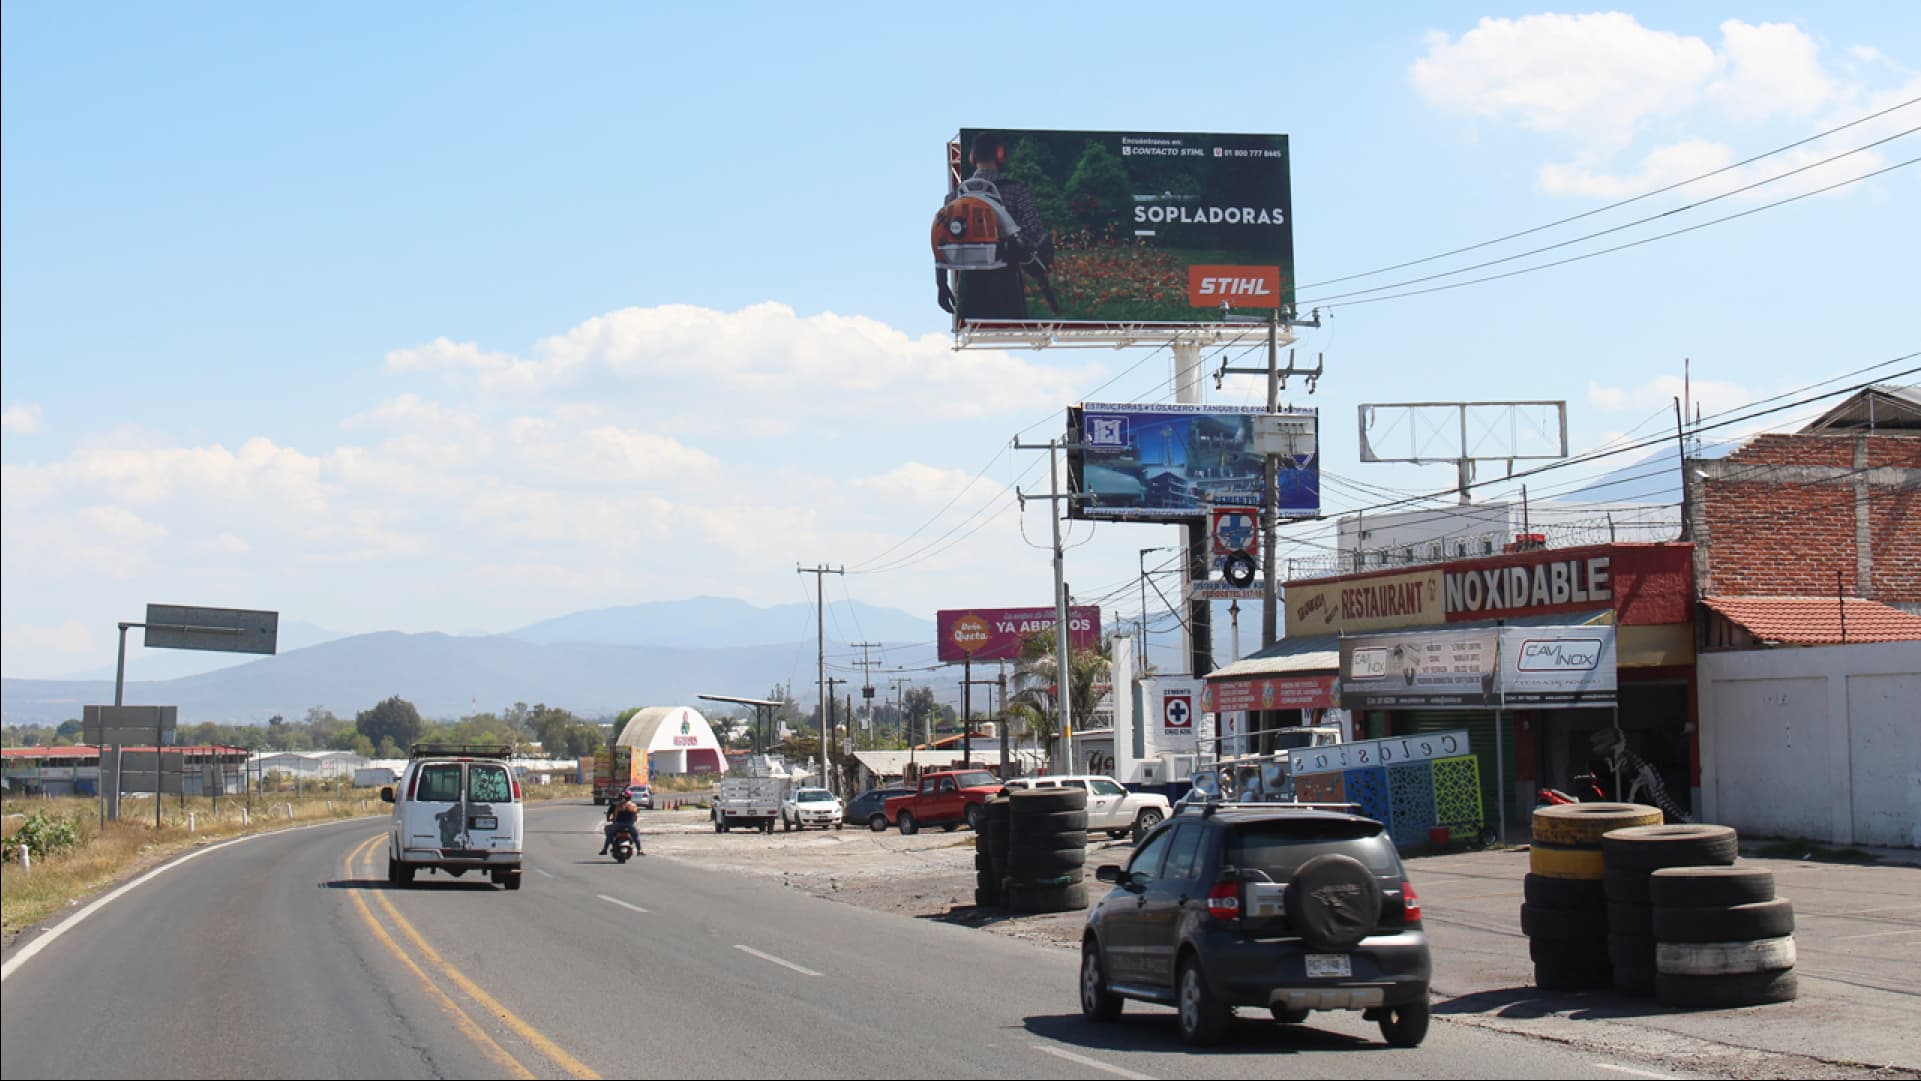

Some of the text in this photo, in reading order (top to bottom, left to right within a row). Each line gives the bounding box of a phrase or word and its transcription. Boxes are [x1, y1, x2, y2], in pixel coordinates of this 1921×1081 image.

[1132, 146, 1204, 156] CONTACTO STIHL
[1249, 149, 1262, 157] 777
[1134, 206, 1284, 225] SOPLADORAS
[1199, 277, 1271, 295] STIHL
[1440, 557, 1612, 613] INOXIDABLE
[1341, 581, 1423, 620] RESTAURANT
[996, 619, 1091, 633] YA ABROS
[1164, 688, 1191, 696] CEMENTO
